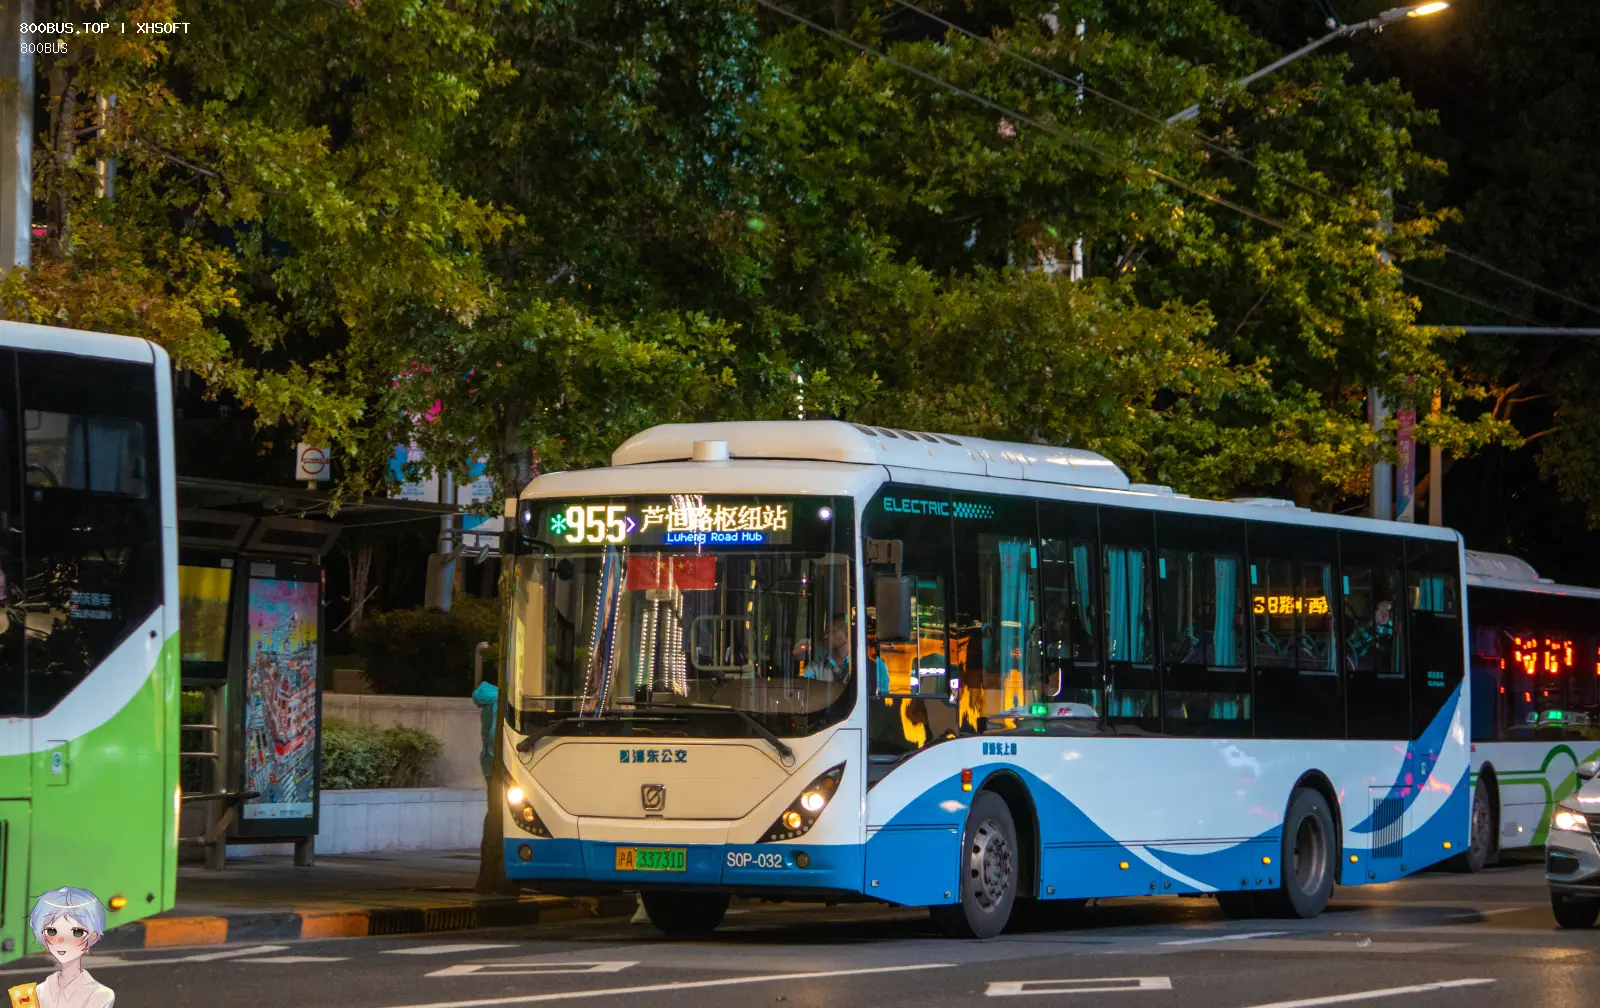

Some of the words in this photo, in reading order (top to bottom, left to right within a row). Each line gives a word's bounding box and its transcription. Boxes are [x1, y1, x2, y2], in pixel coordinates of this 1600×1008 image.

[883, 497, 950, 516] ELECTRIC
[565, 505, 627, 543] 955
[640, 504, 788, 532] 芦恒路枢纽站
[667, 532, 706, 544] Luheng
[711, 532, 738, 542] Road
[742, 532, 763, 542] Hub
